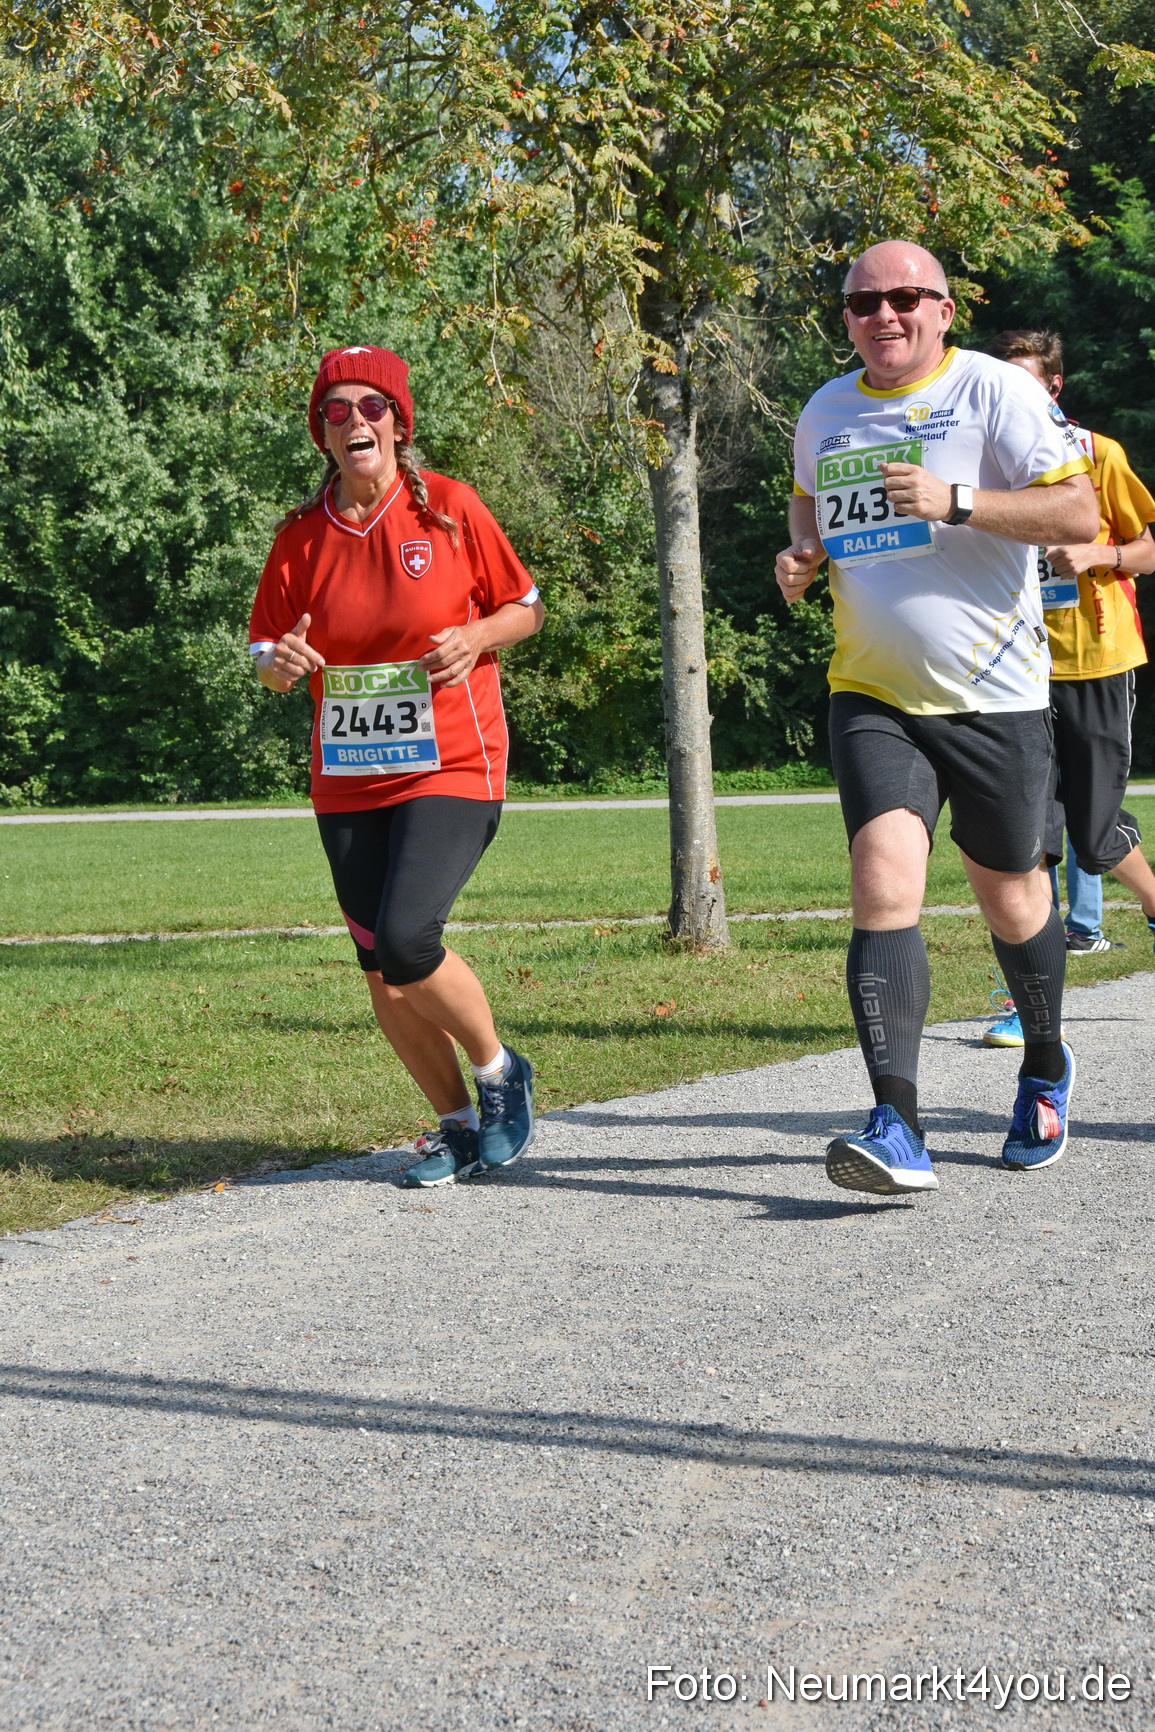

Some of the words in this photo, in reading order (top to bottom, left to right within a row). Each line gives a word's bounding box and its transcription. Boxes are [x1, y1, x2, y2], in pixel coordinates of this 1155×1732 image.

[907, 406, 930, 422] 20
[931, 409, 952, 419] JAHRE
[905, 420, 960, 433] Neumarkter
[820, 434, 851, 451] BOCK
[821, 444, 912, 487] BOCK
[826, 486, 909, 530] 243
[843, 530, 900, 554] RALPH
[1012, 619, 1026, 636] 2019
[328, 665, 420, 695] BOCK
[331, 701, 419, 738] 2443
[337, 744, 420, 763] BRIGITTE
